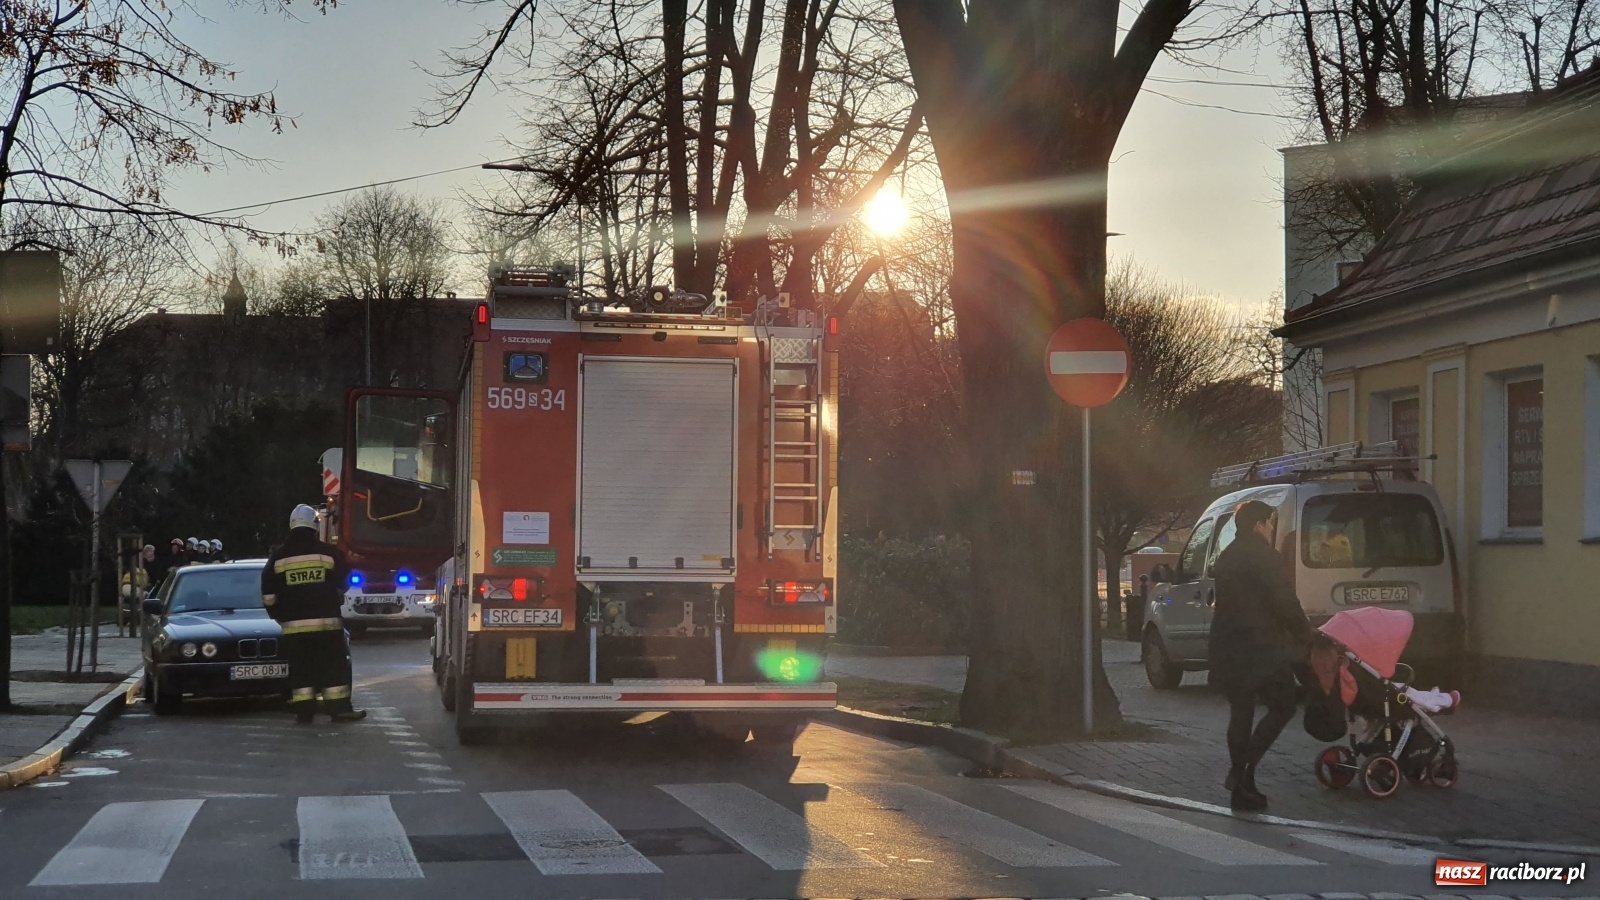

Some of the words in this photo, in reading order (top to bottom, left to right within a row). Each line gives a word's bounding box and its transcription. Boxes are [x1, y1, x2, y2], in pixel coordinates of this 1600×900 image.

[1353, 588, 1377, 600] SRC
[1380, 587, 1407, 600] E762
[492, 609, 519, 623] SRC
[523, 610, 559, 623] EF34
[236, 666, 259, 677] SRC
